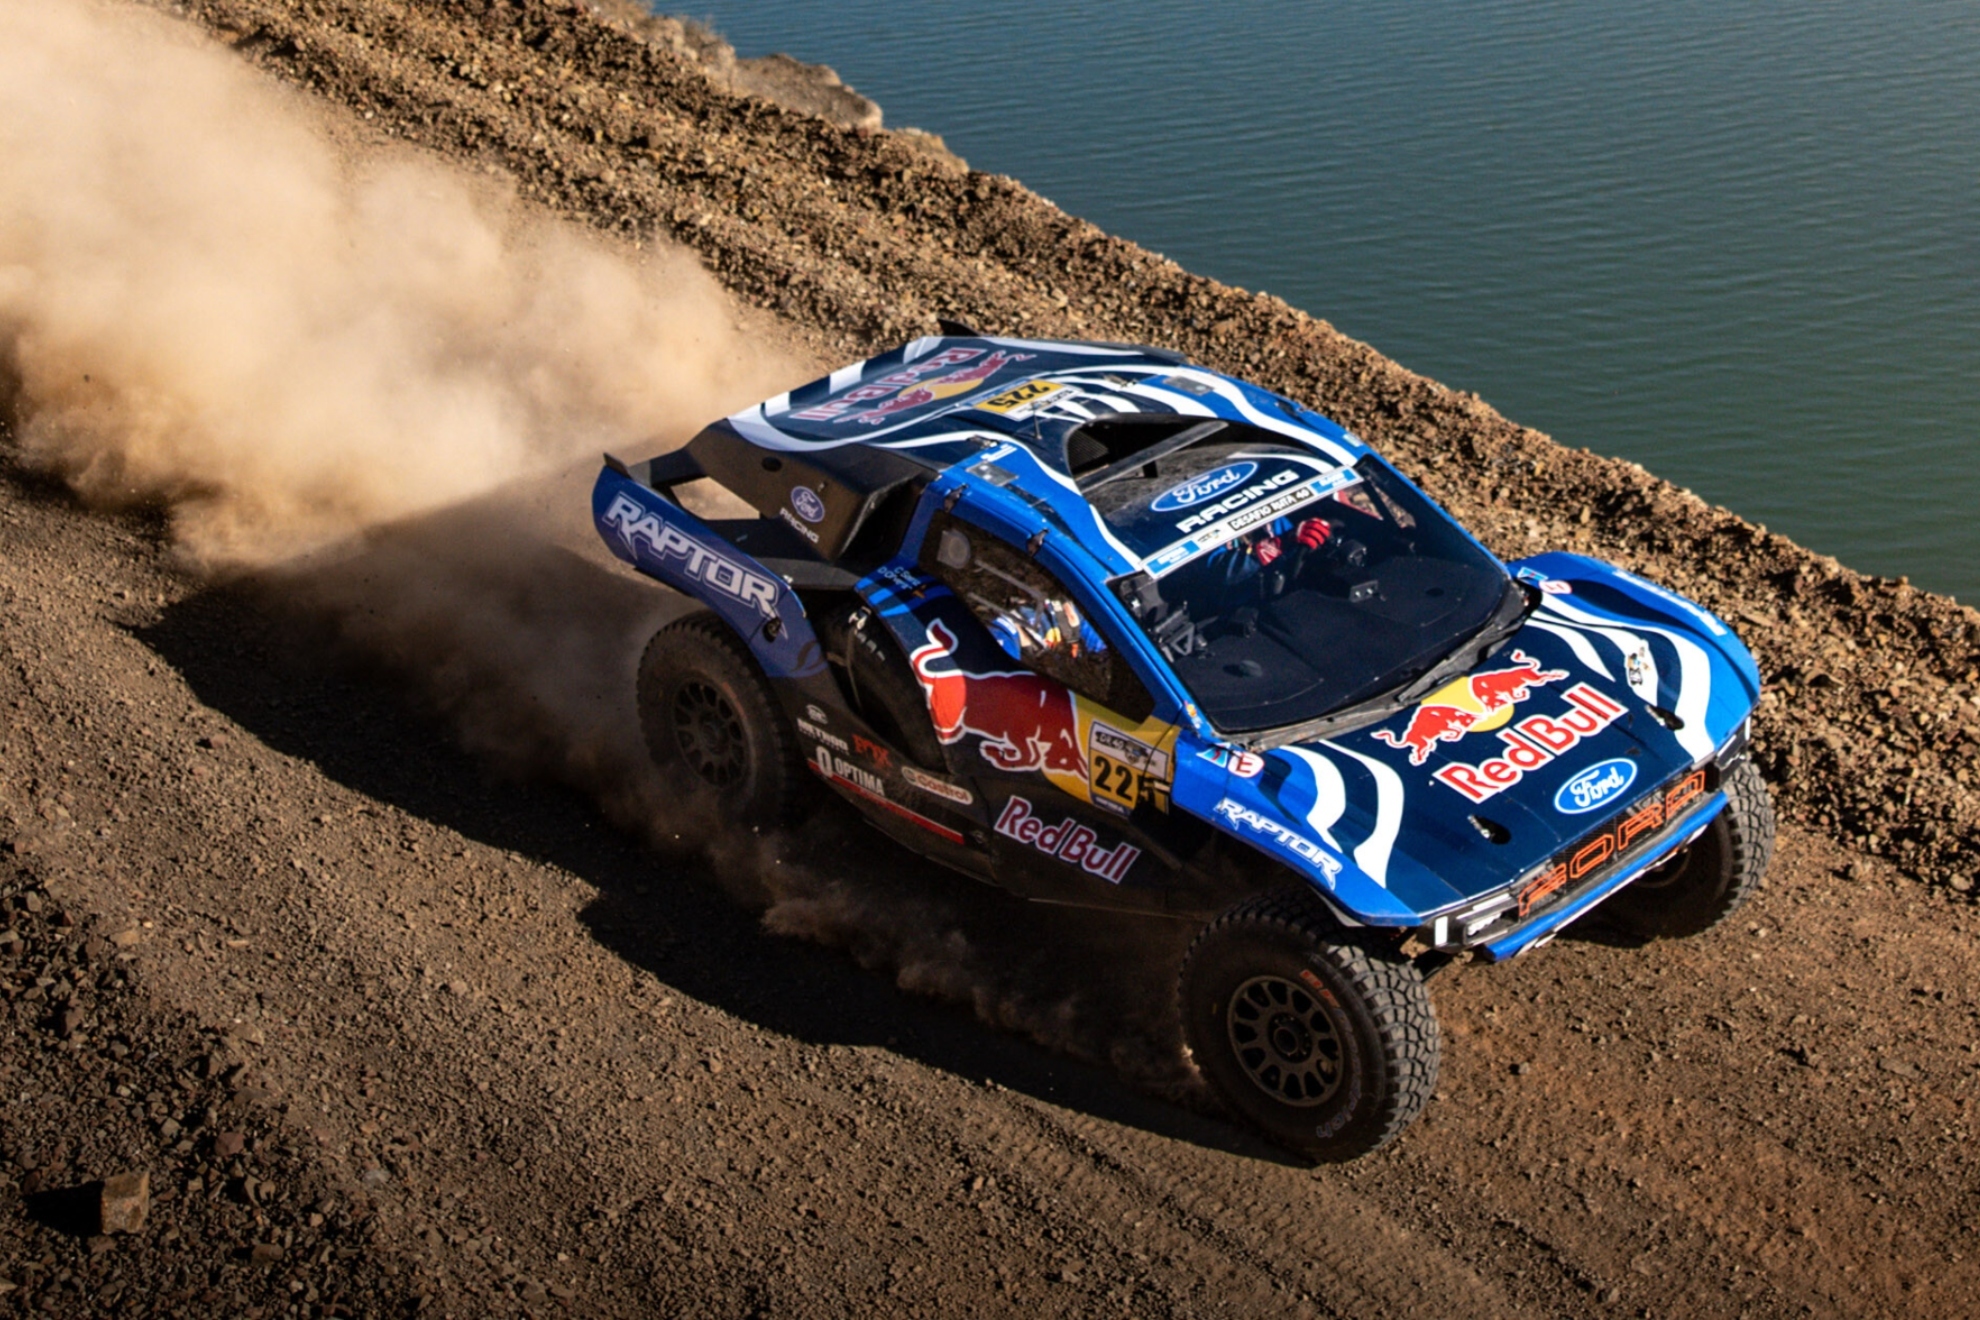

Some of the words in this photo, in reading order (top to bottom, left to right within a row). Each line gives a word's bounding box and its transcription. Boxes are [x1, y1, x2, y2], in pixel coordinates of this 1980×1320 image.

[987, 384, 1050, 408] 225
[1173, 469, 1240, 503] Ford
[1176, 469, 1300, 533] RACING
[779, 507, 819, 544] RACING
[604, 492, 784, 633] RAPTOR
[834, 758, 885, 797] OPTIMA
[917, 774, 970, 801] Castrol
[1571, 770, 1625, 804] Ford
[1213, 797, 1343, 890] RAPTOR
[1517, 770, 1706, 917] FORD
